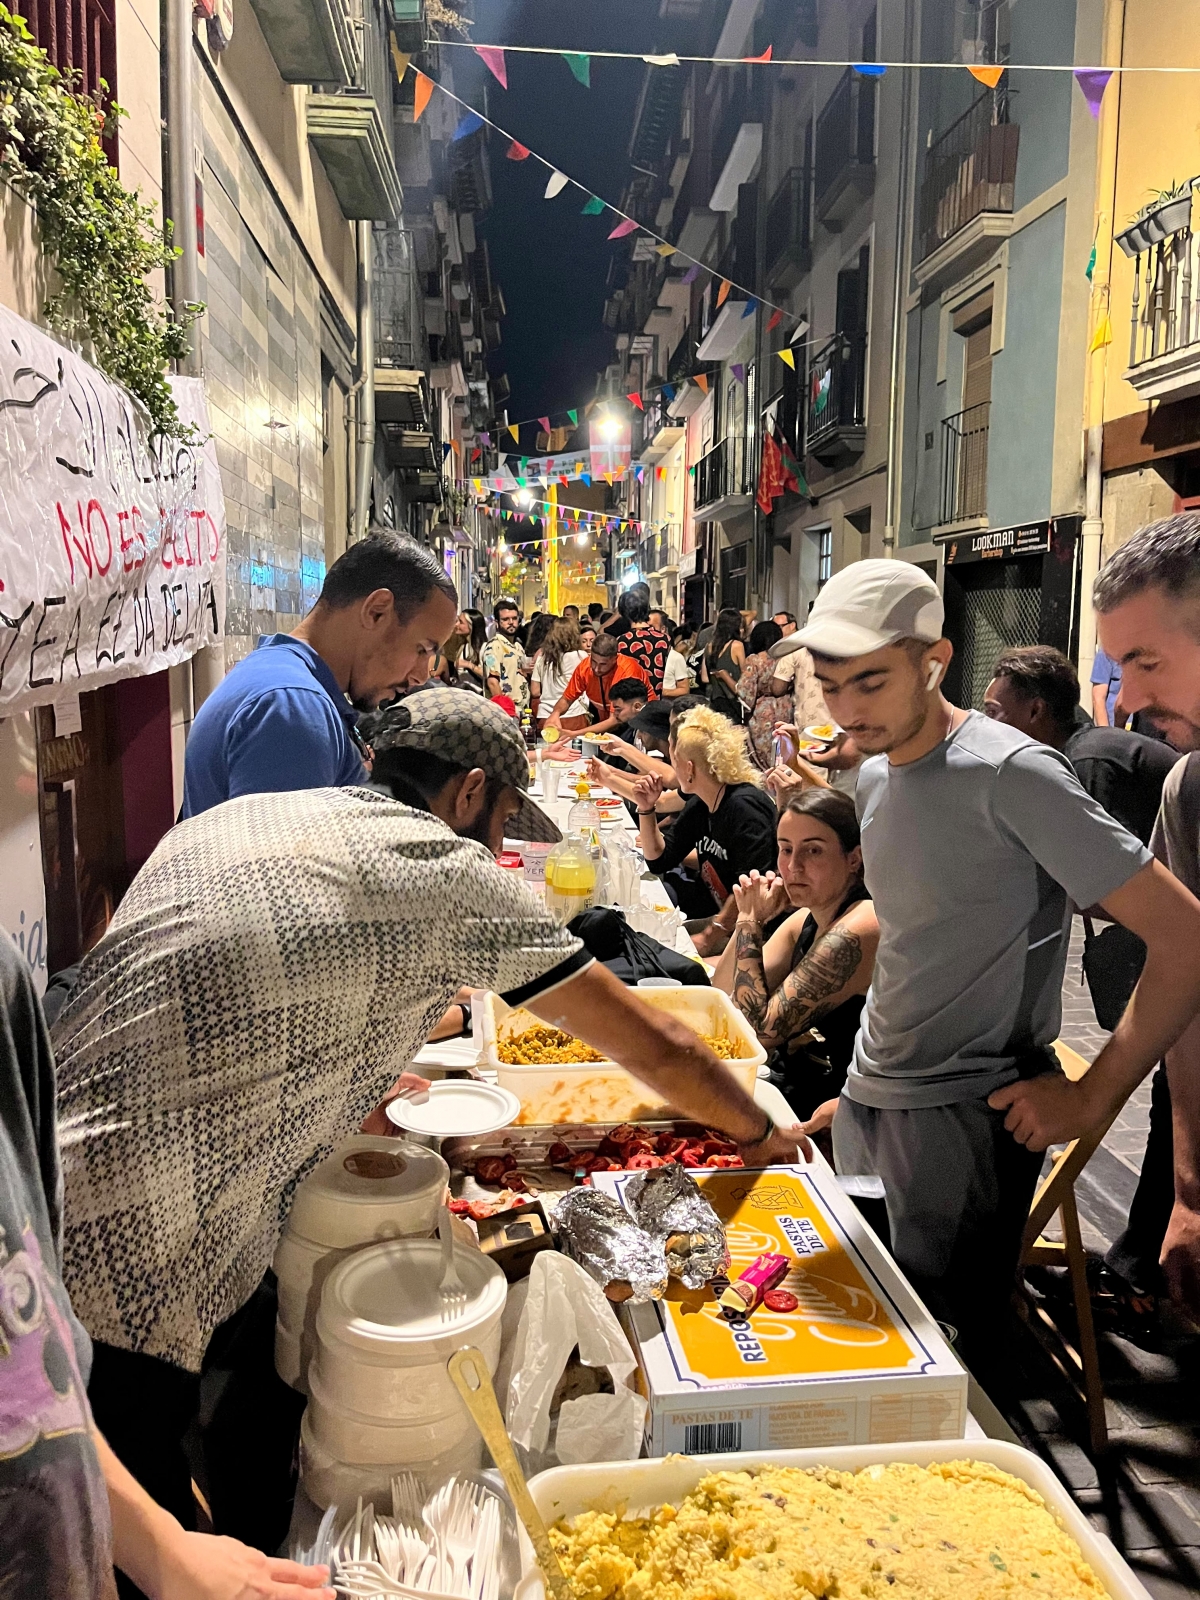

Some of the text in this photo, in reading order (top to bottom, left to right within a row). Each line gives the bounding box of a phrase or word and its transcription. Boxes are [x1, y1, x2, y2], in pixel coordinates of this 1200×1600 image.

[56, 498, 113, 585] NO
[971, 530, 1014, 551] LOOKMAN
[779, 1217, 811, 1255] PASTAS
[805, 1234, 825, 1249] DE
[671, 1411, 716, 1425] PASTAS
[718, 1410, 737, 1422] DE
